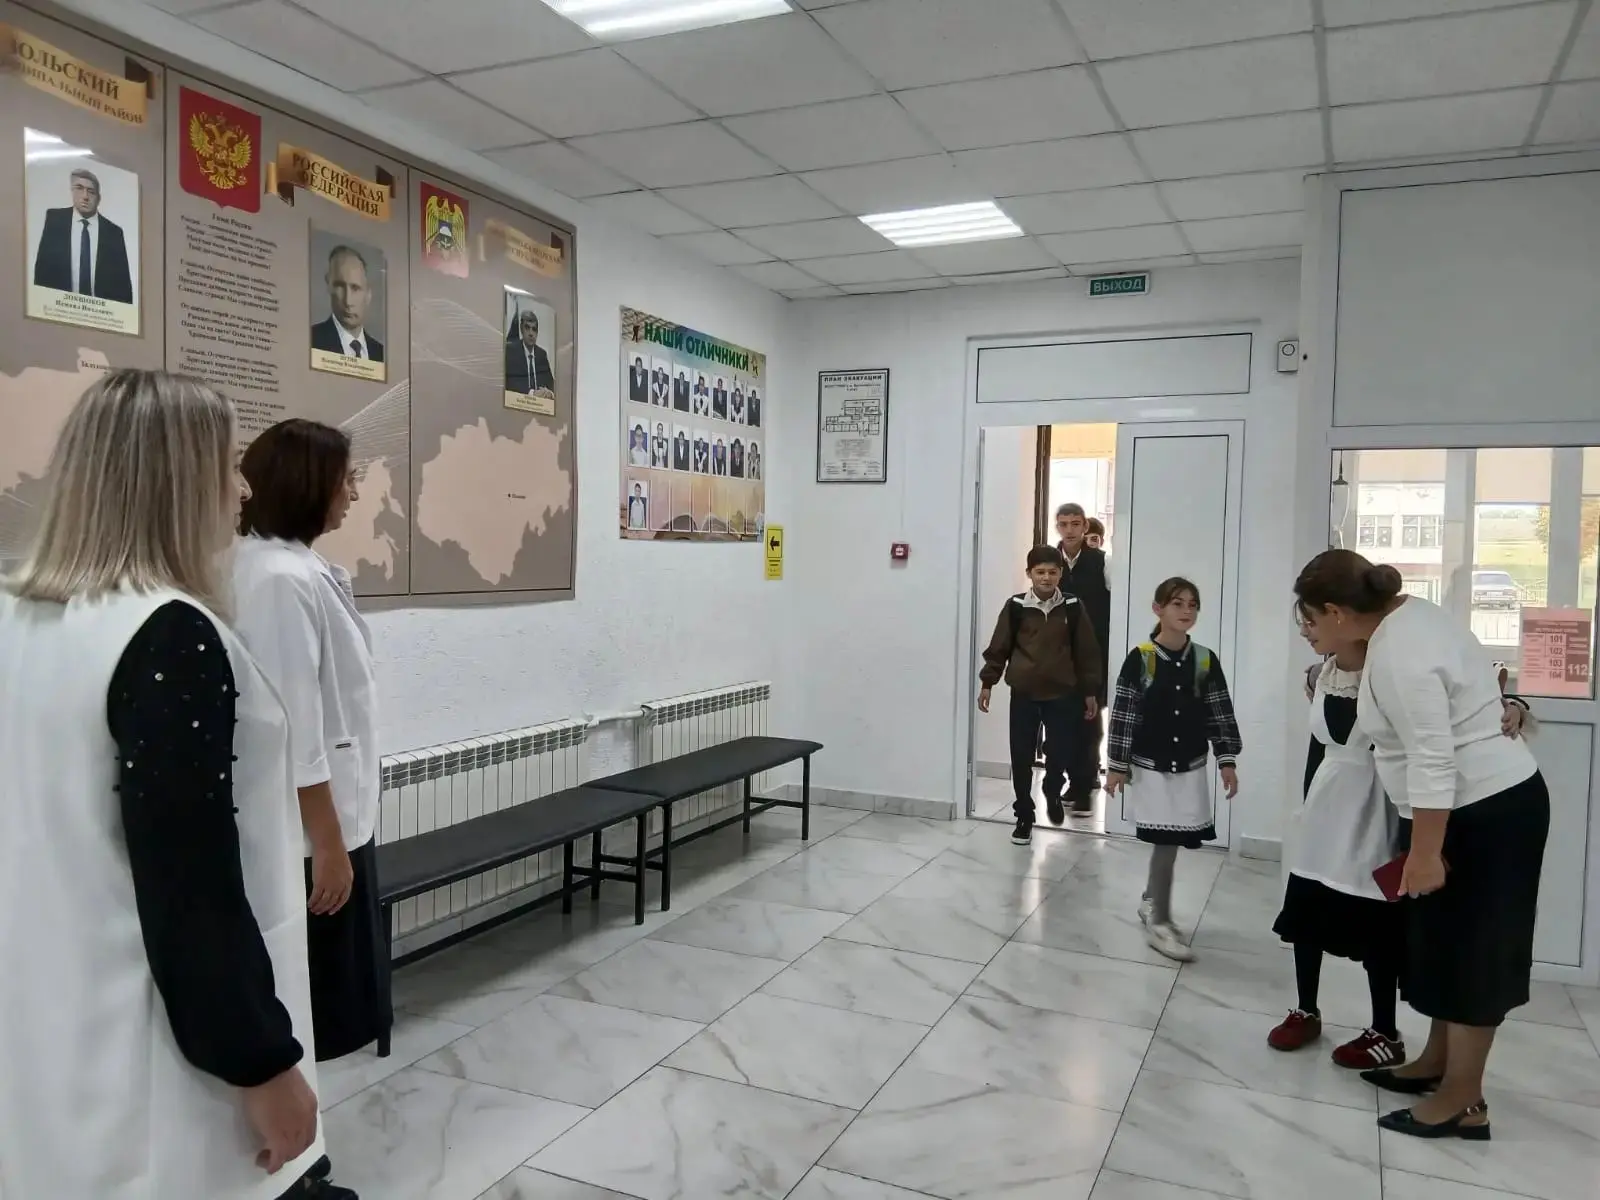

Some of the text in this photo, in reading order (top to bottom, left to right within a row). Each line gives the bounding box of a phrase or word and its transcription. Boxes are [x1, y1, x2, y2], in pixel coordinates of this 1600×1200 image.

[15, 41, 120, 100] ОЛЬСКИЙ
[293, 152, 384, 203] РОССИЙСКАЯ
[1093, 278, 1143, 293] ВЫХОД
[644, 321, 749, 372] НАШИ ОТЛИЧНИКИ
[1550, 635, 1563, 644] 101
[1550, 647, 1563, 656] 102
[1550, 660, 1562, 668] 103
[1567, 663, 1589, 677] 112
